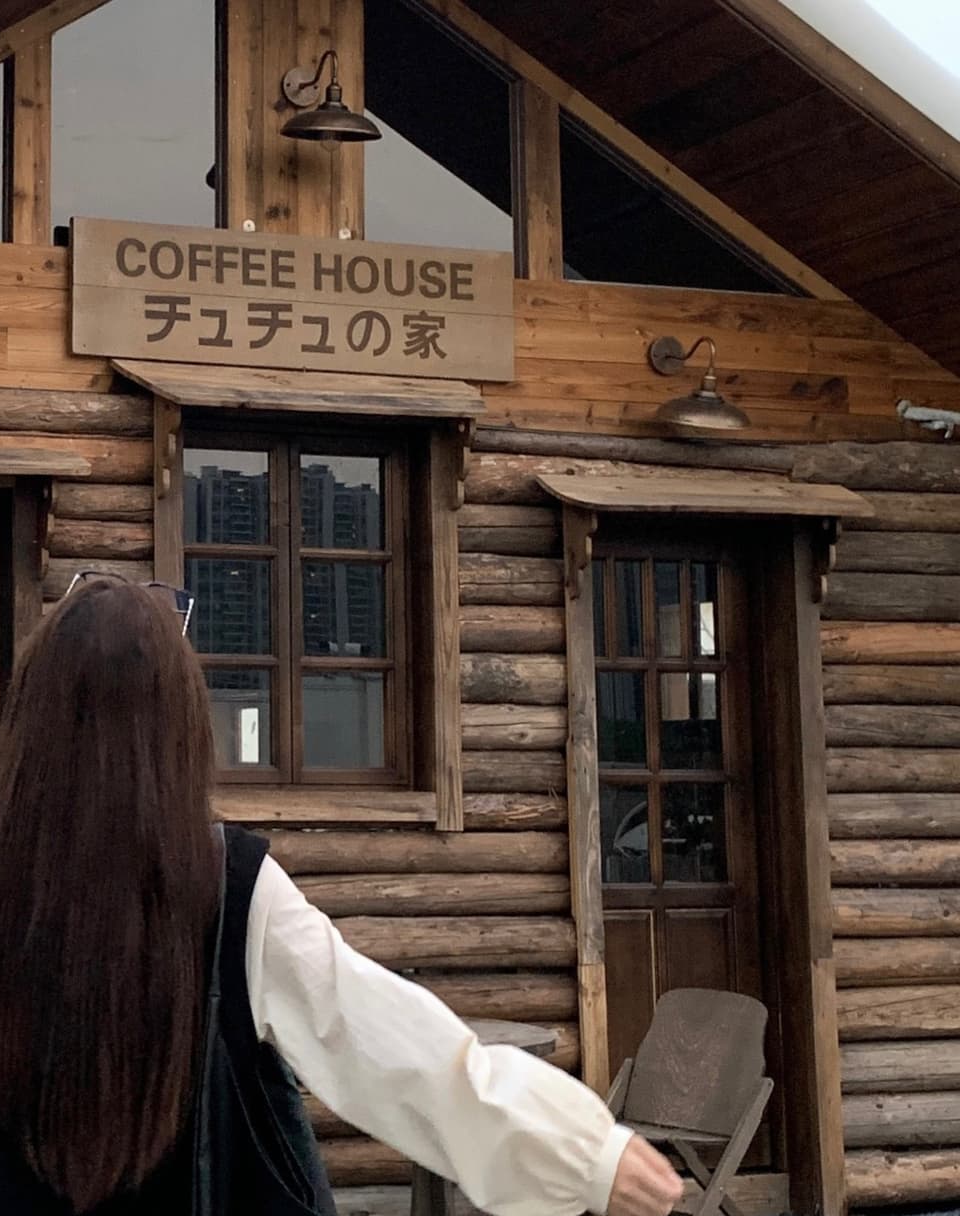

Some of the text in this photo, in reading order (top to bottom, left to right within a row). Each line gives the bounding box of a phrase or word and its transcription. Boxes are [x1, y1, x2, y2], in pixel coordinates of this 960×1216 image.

[115, 238, 474, 300] COFFEE HOUSE
[144, 295, 447, 359] チュチュの家
